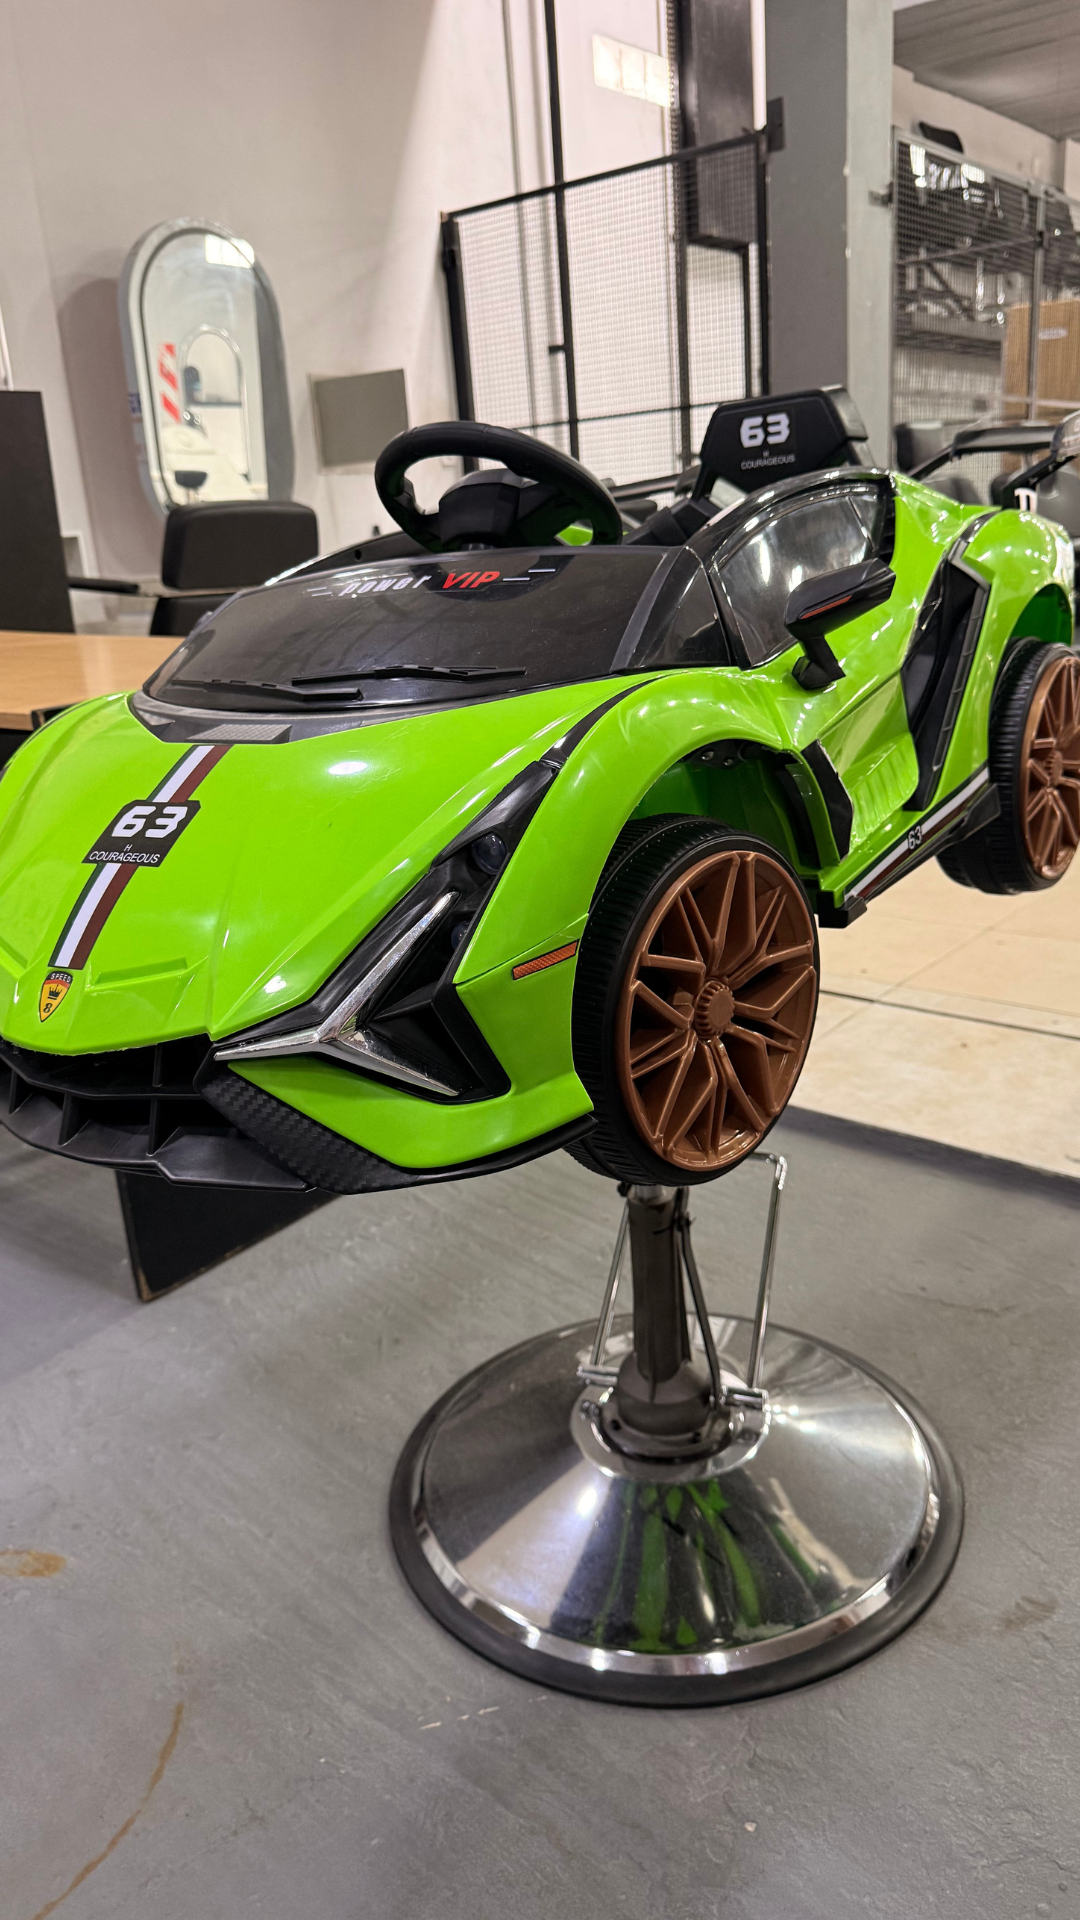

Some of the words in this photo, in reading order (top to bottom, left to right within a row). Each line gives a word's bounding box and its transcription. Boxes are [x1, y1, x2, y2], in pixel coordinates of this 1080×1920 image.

[740, 413, 790, 448] 63
[741, 455, 795, 470] COURAGEOUS
[339, 575, 432, 597] power
[443, 571, 500, 589] VIP
[111, 806, 188, 838] 63
[908, 825, 922, 850] 63
[124, 844, 133, 852] H
[89, 851, 160, 864] COURAGEOUS
[50, 973, 72, 983] SPEED
[43, 1002, 53, 1013] 8
